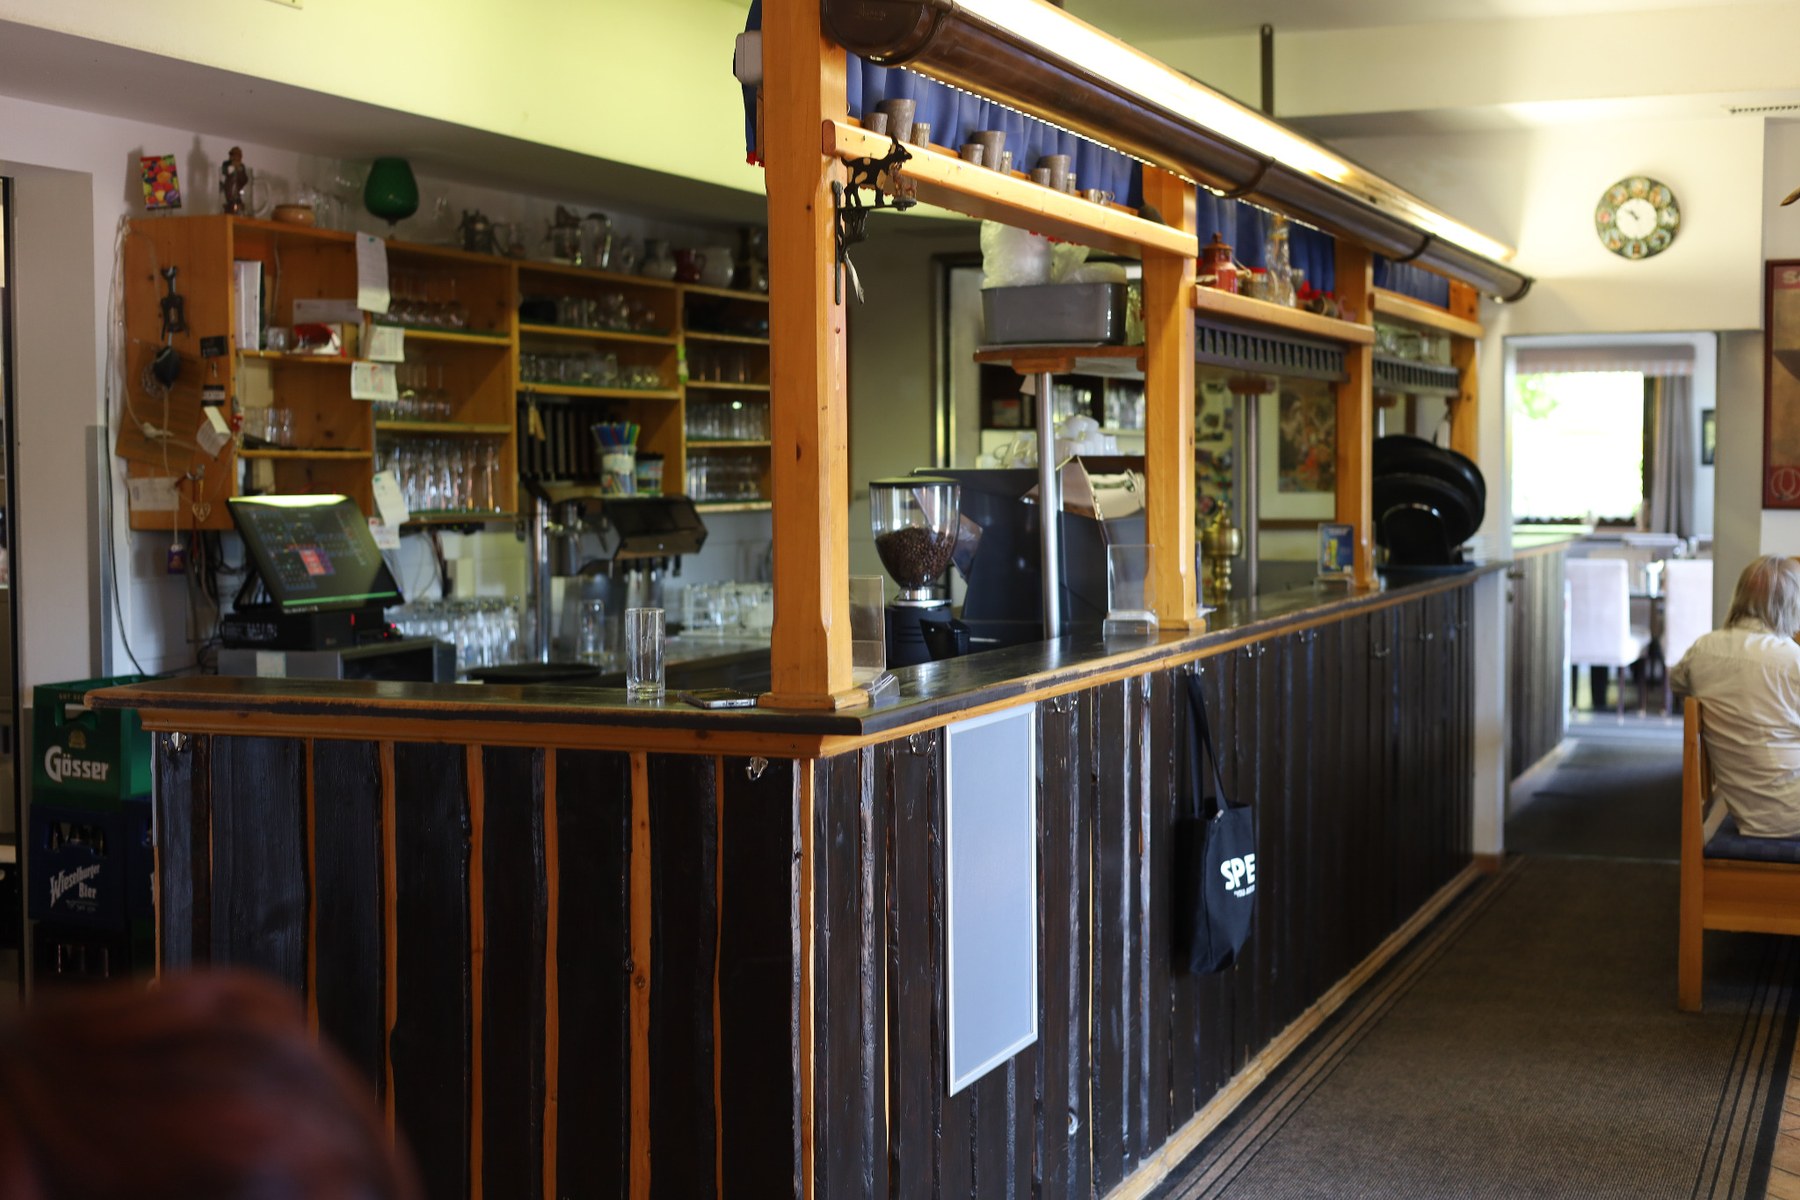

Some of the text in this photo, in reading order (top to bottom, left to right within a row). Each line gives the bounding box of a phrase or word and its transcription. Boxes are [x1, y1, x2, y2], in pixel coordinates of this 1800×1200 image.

[44, 745, 109, 783] Gösser
[50, 864, 100, 908] Wieselburger
[79, 881, 97, 899] Bier
[1220, 853, 1256, 891] SPE
